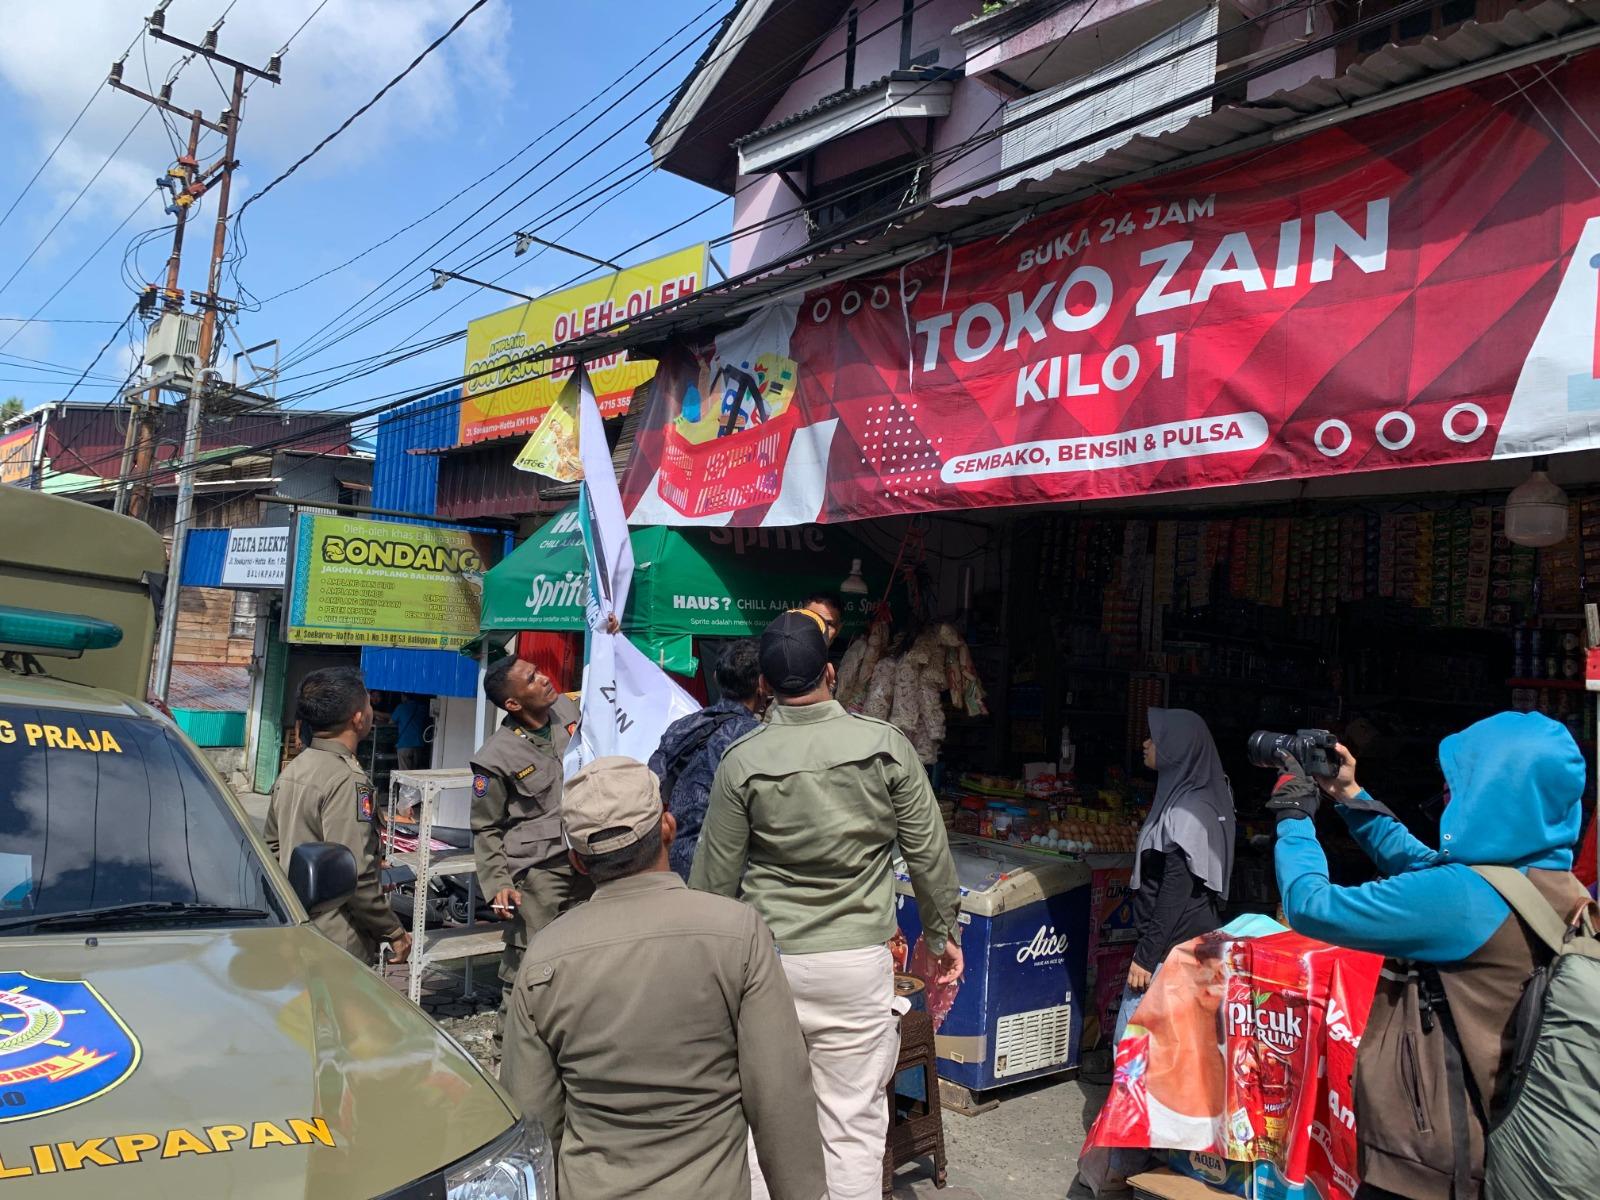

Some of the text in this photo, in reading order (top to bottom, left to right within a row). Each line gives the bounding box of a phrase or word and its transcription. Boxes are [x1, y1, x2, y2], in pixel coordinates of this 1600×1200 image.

[1018, 193, 1216, 273] BUKA 24 JAM
[916, 198, 1392, 373] TOKO ZAIN
[1015, 333, 1178, 407] KILO 1
[953, 420, 1245, 477] SEMBAKO, BENSIN & PULSA
[231, 536, 256, 553] DELTA
[322, 536, 482, 574] BONDANG
[321, 565, 364, 575] JAGONYA
[366, 568, 409, 579] AMPLANG
[737, 598, 764, 610] CHILL
[690, 617, 710, 626] Sprite
[711, 617, 733, 625] adalah
[24, 723, 122, 754] PRAJA
[1016, 925, 1069, 964] Aice
[1195, 1152, 1222, 1171] AQUA
